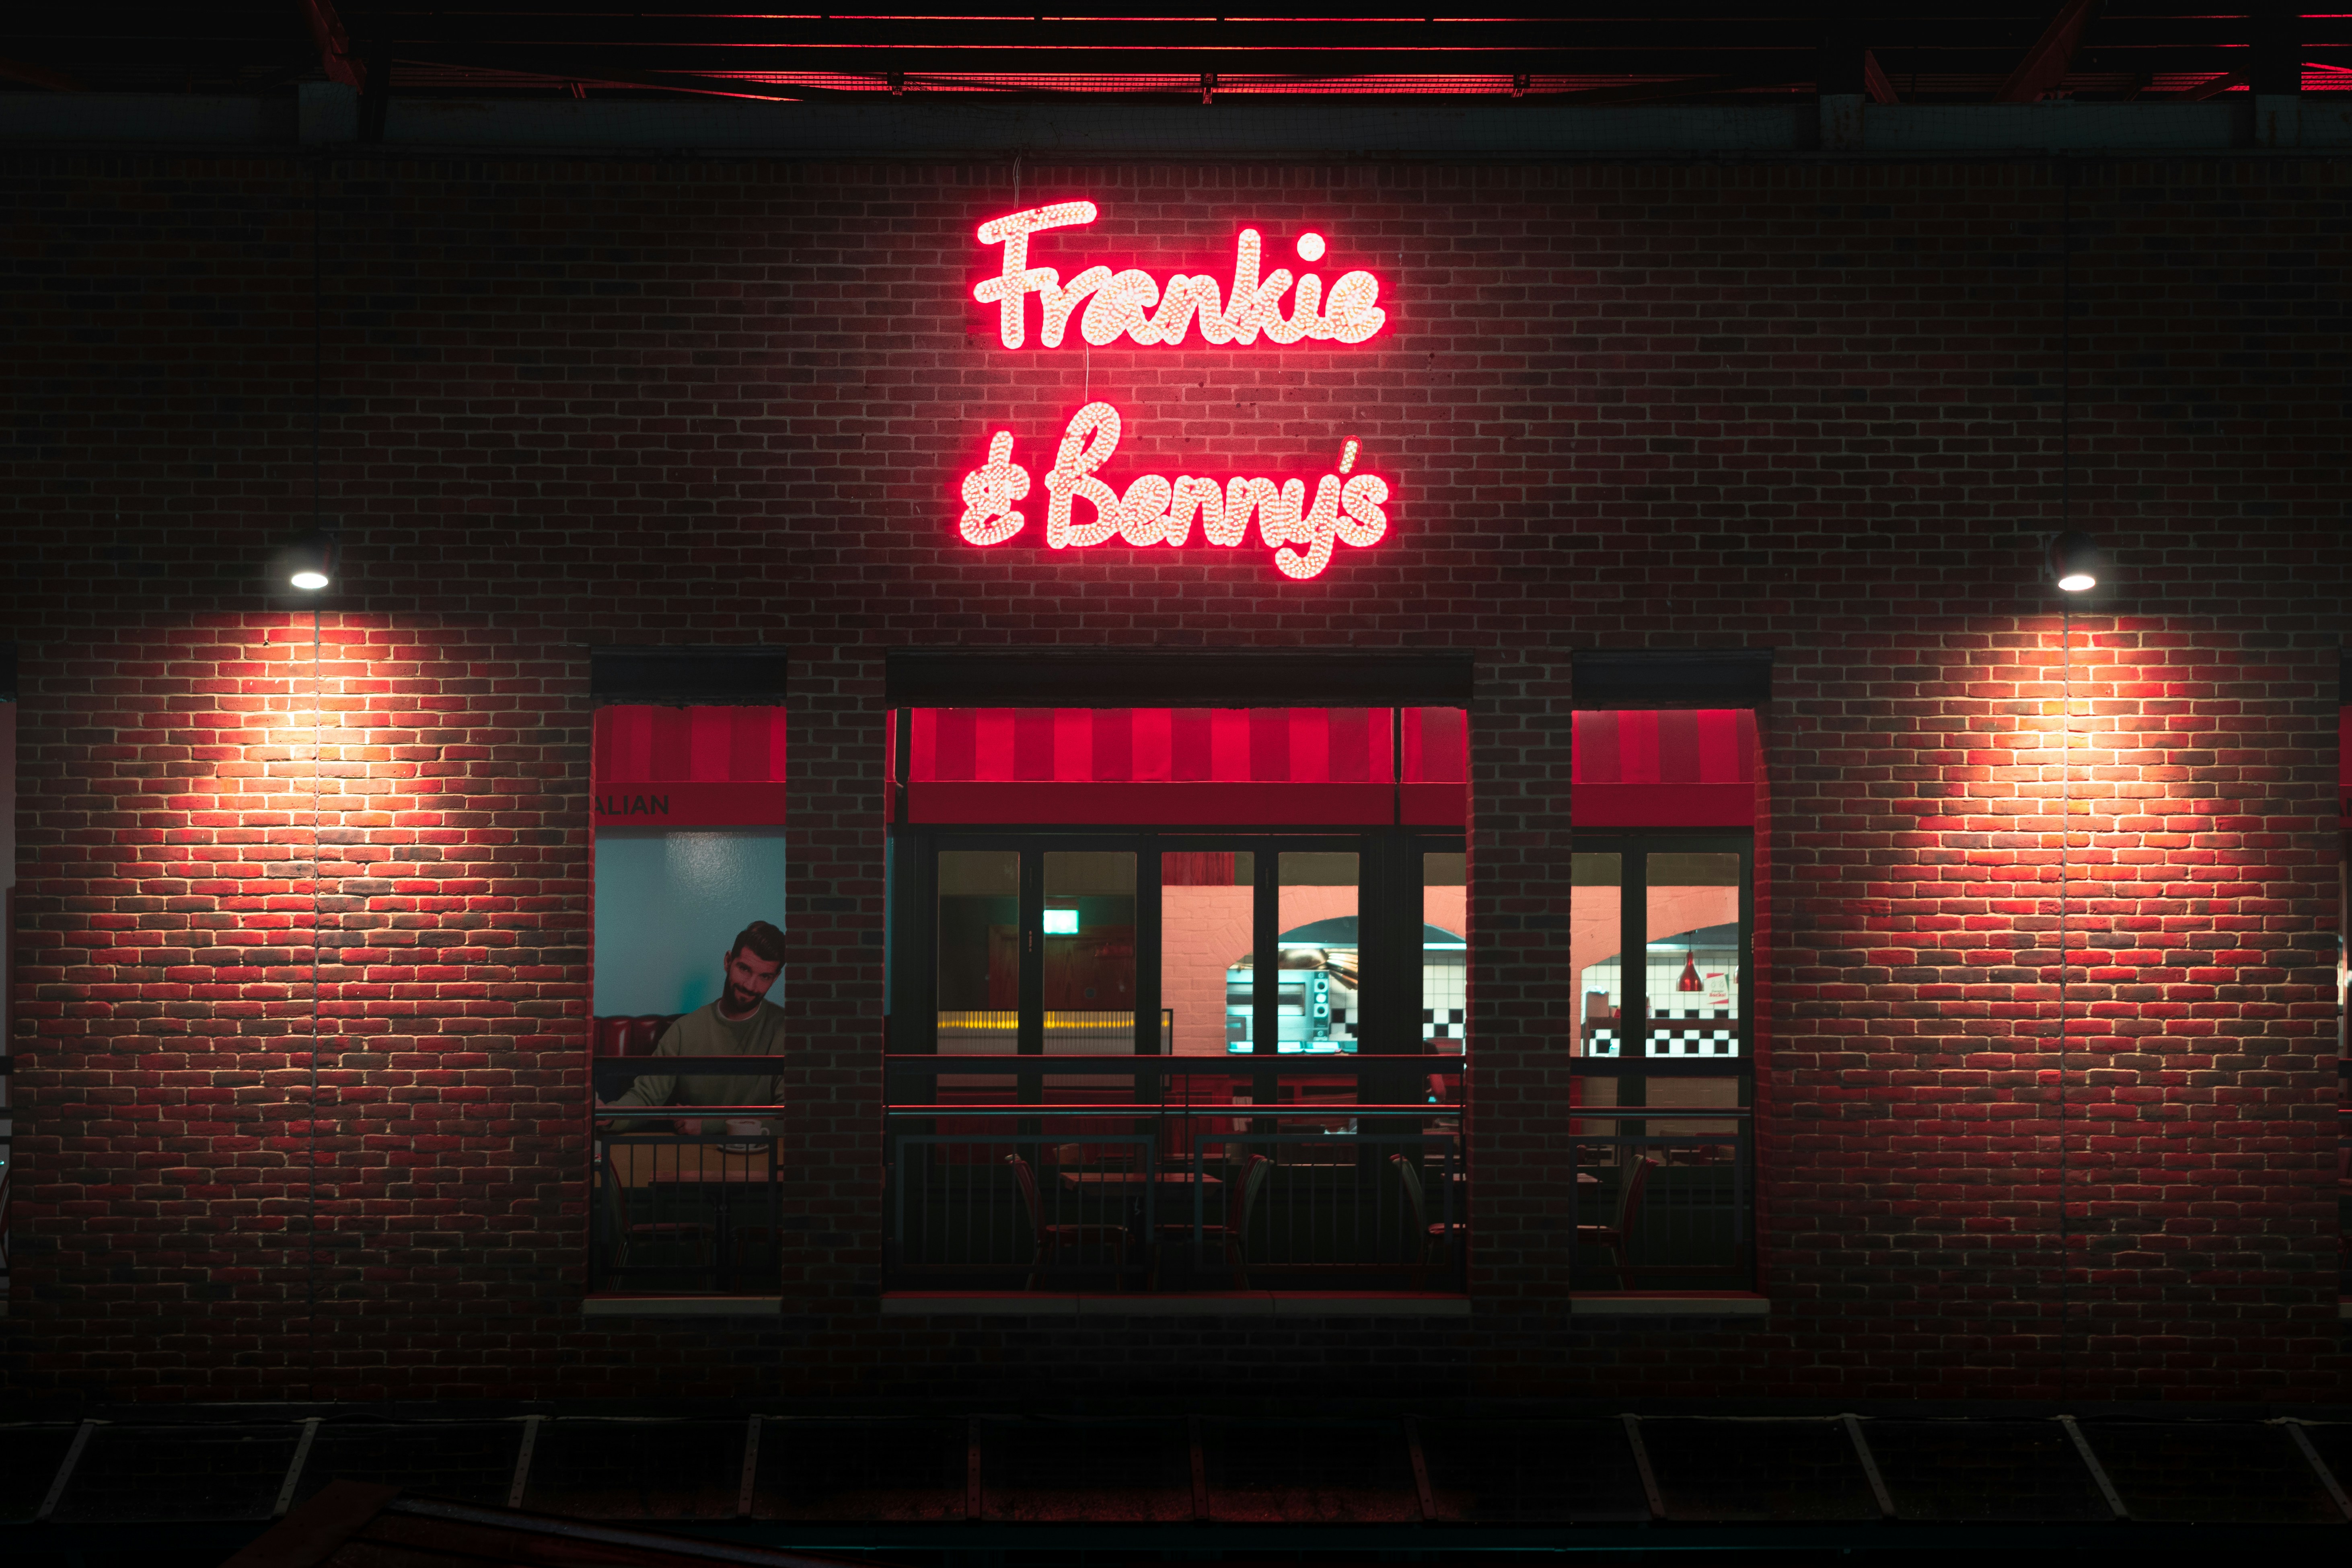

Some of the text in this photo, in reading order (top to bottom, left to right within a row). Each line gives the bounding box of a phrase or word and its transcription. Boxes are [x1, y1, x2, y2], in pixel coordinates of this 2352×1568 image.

[973, 201, 1385, 349] Frankie
[960, 402, 1388, 579] & Benny's
